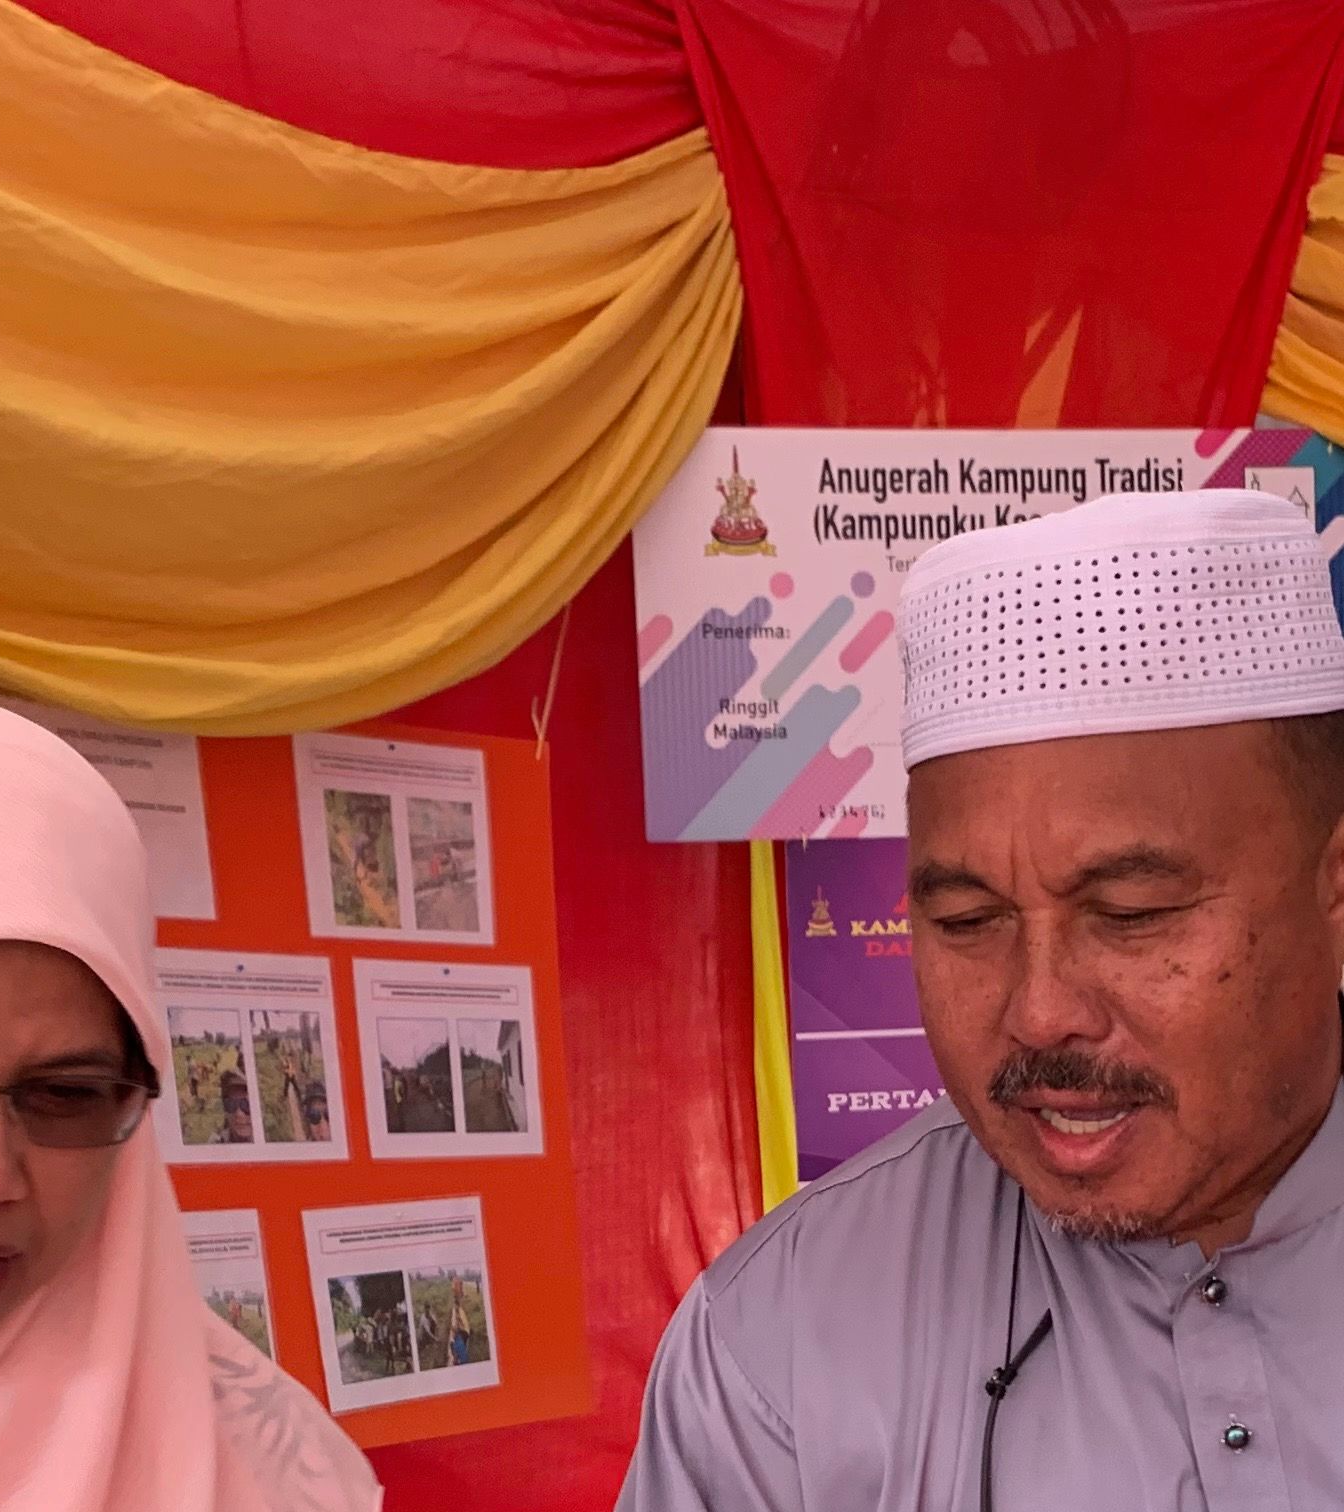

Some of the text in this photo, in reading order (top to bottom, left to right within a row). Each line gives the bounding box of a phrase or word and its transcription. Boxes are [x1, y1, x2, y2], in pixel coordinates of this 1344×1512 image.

[818, 457, 1184, 504] Anugerah Kampung Tradisi
[812, 504, 986, 550] (Kampungku
[701, 623, 791, 640] Penerima:
[719, 698, 780, 719] Ringgit
[713, 723, 789, 741] Malaysia
[849, 918, 913, 937] KAM
